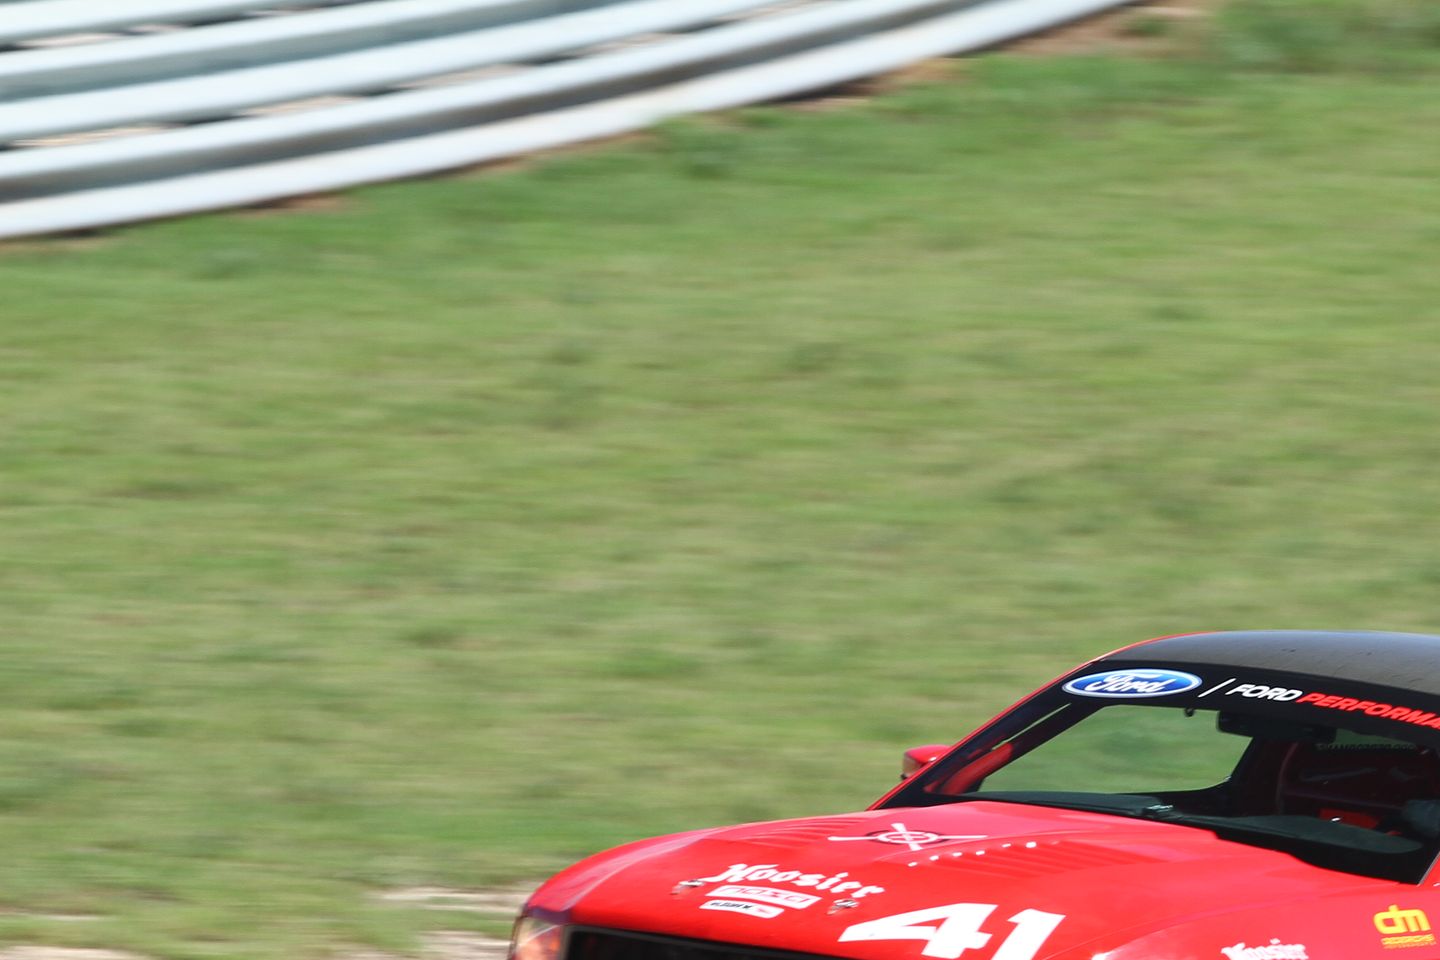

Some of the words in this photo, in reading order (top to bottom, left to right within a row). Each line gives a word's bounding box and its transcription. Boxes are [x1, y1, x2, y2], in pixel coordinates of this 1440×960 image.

[1091, 673, 1168, 695] Ford
[1229, 683, 1302, 702] FORD
[700, 863, 885, 898] Hoosier
